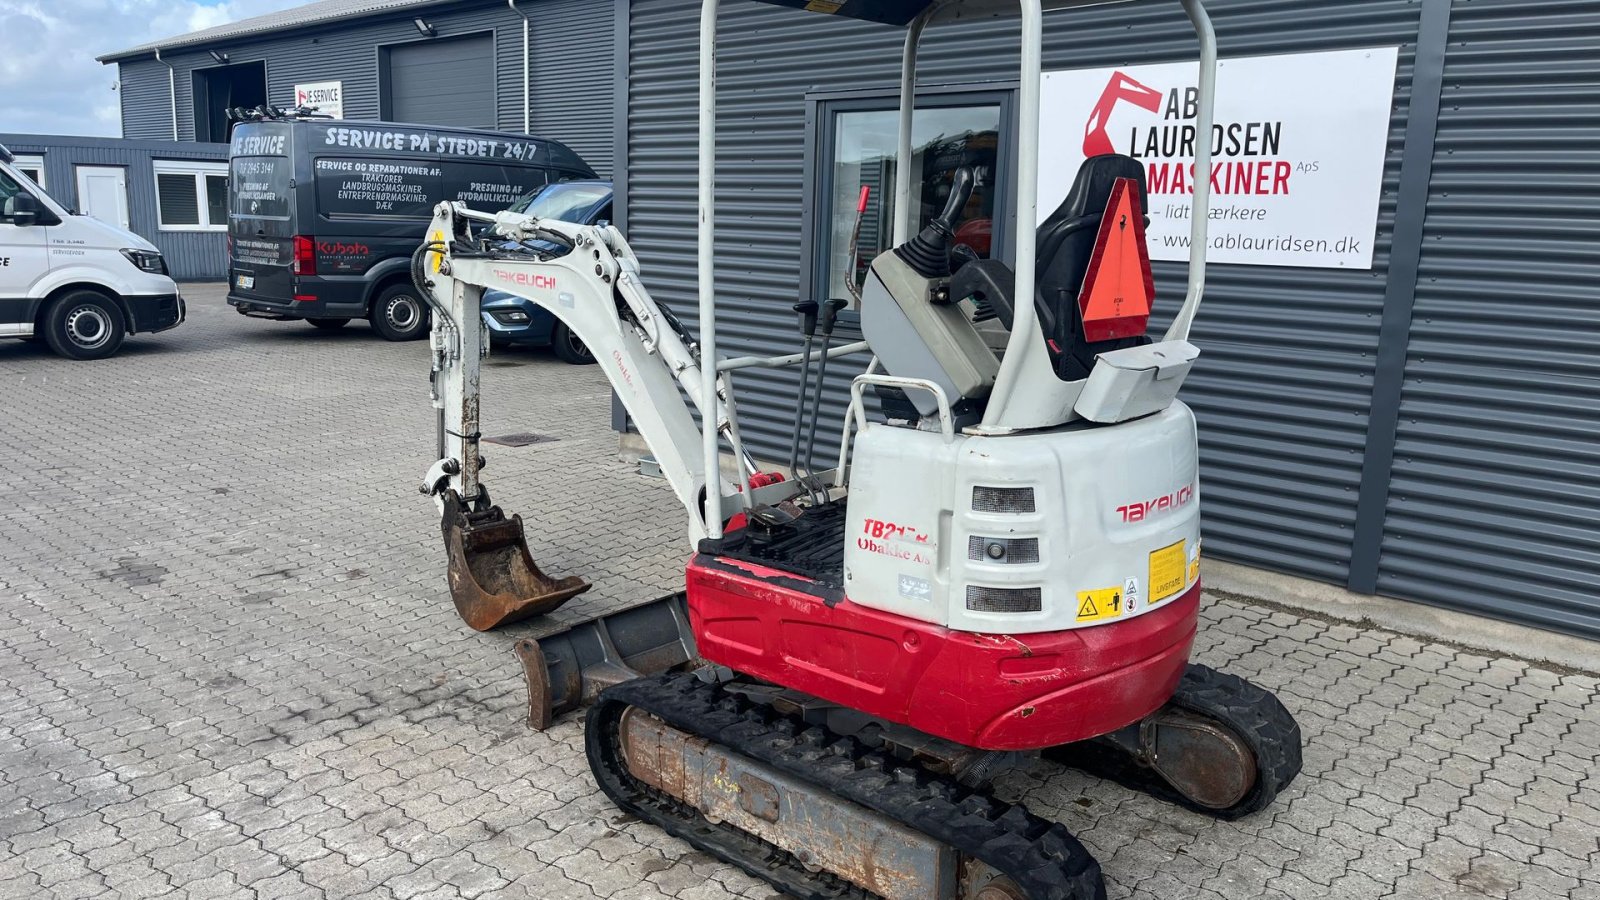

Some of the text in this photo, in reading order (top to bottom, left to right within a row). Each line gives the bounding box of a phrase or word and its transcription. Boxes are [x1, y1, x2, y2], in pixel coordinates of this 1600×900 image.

[313, 88, 338, 103] SERVICE
[1164, 87, 1199, 120] AB
[243, 135, 285, 155] SERVICE
[325, 127, 537, 160] SERVICE PÅ STEDET 24/7
[1130, 121, 1281, 158] LAURDSEN
[316, 160, 442, 176] SERVICE OG REPARATIONER AF:
[1296, 161, 1319, 174] ApS
[362, 173, 403, 184] TRAKTORER
[342, 181, 422, 194] LANDBRUGSMASKINER
[470, 182, 523, 194] PRESNING AF
[338, 190, 427, 203] ENTREPRENØRMASKINER
[457, 191, 522, 203] HYDRAULIKSLAN
[1165, 204, 1190, 219] lidt
[316, 241, 369, 254] Kubota
